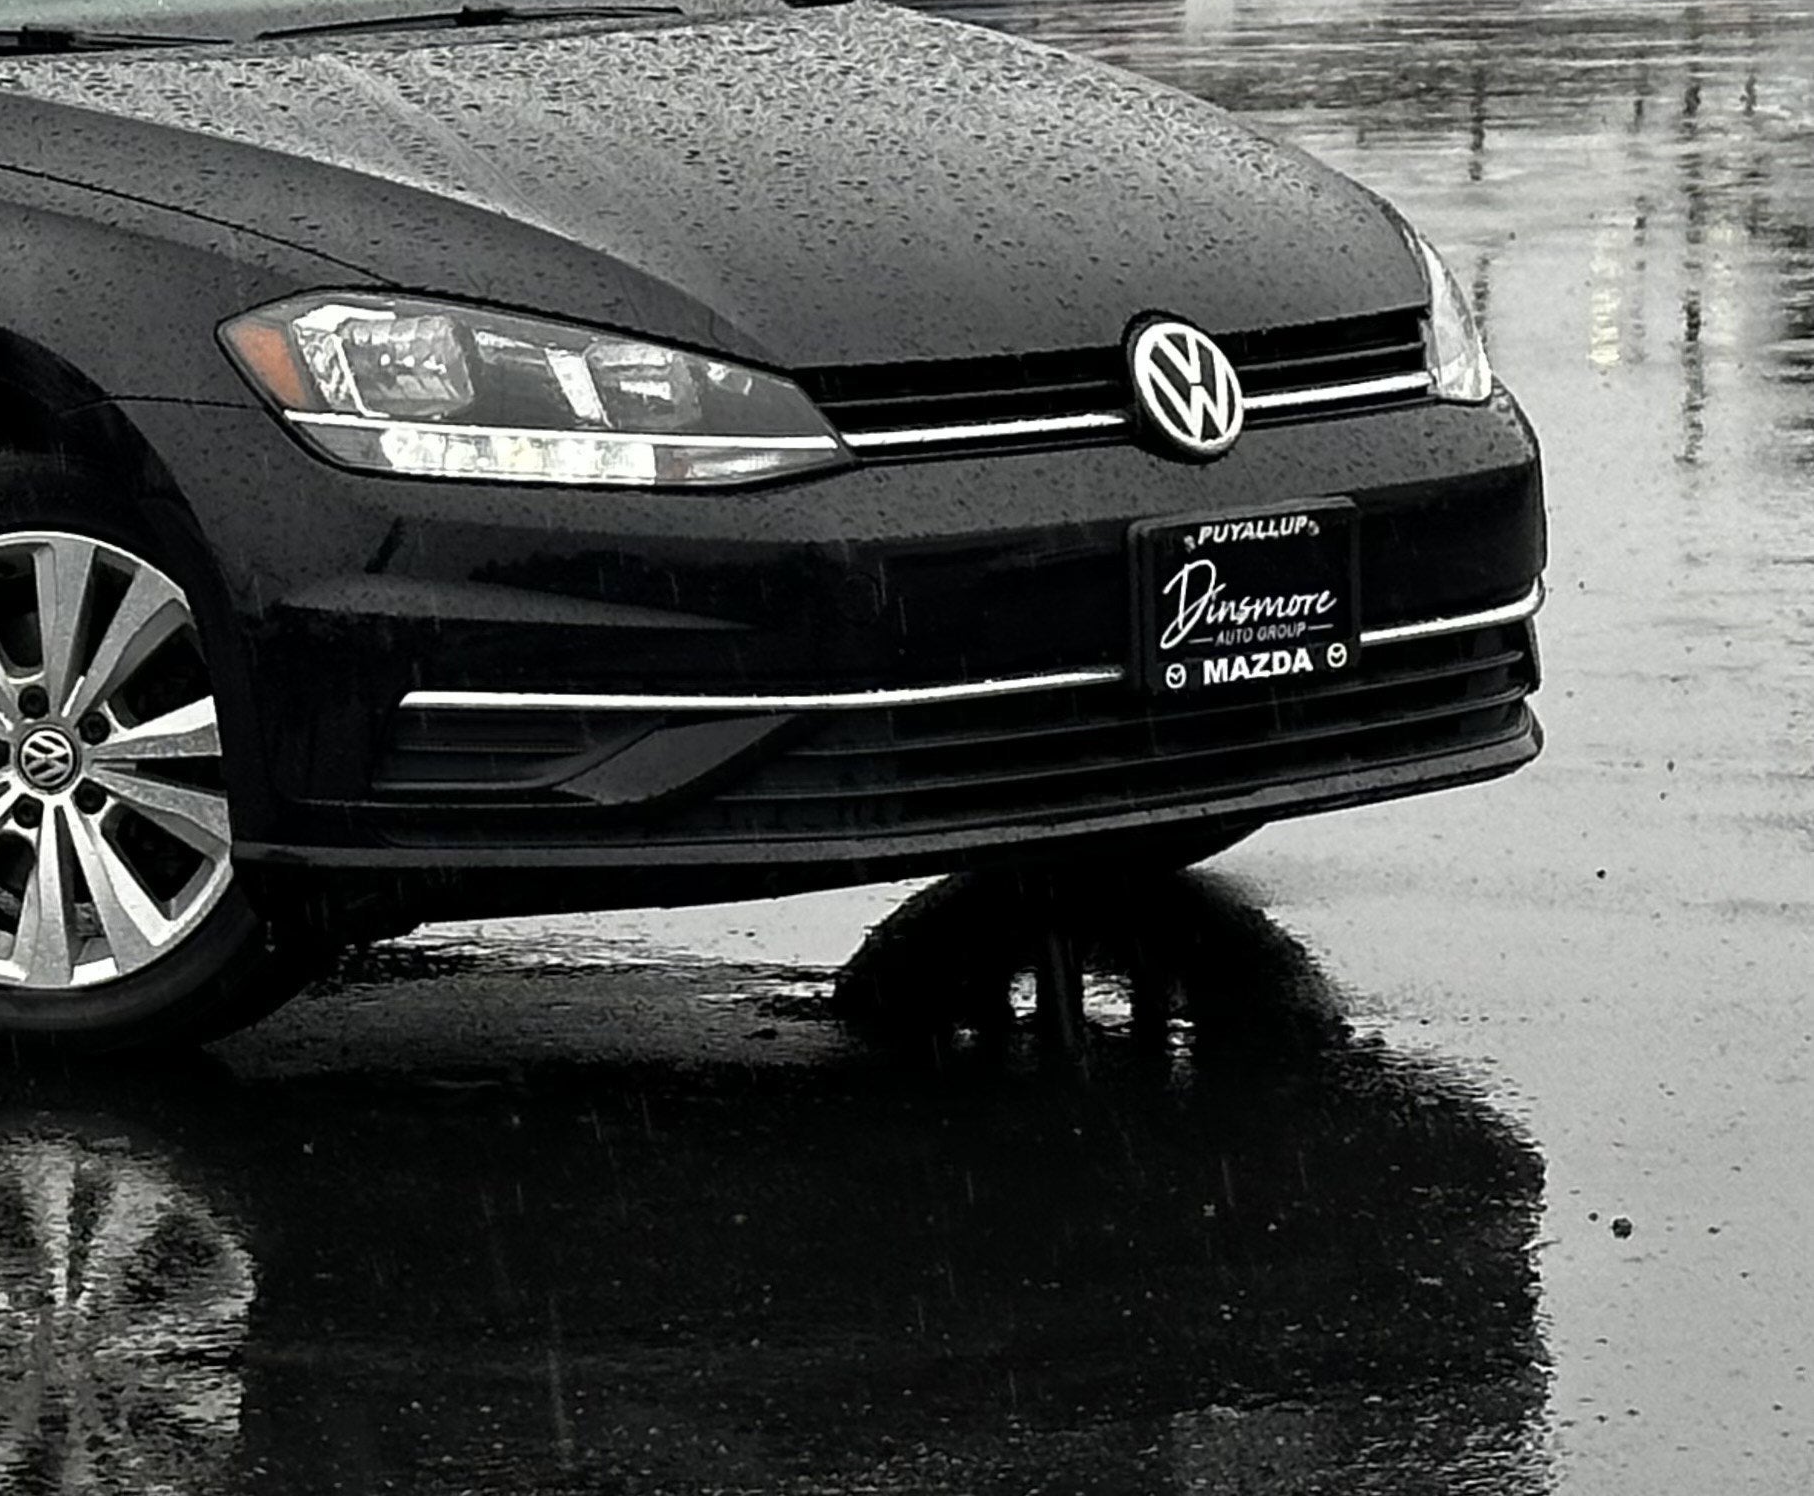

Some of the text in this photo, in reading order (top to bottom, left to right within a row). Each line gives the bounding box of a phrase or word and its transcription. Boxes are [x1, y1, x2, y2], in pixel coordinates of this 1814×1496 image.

[1197, 515, 1308, 545] PUYALLUP
[1160, 559, 1337, 650] Dinsmore
[1215, 621, 1307, 647] AUTO GROUP
[1202, 647, 1314, 686] MAZDA
